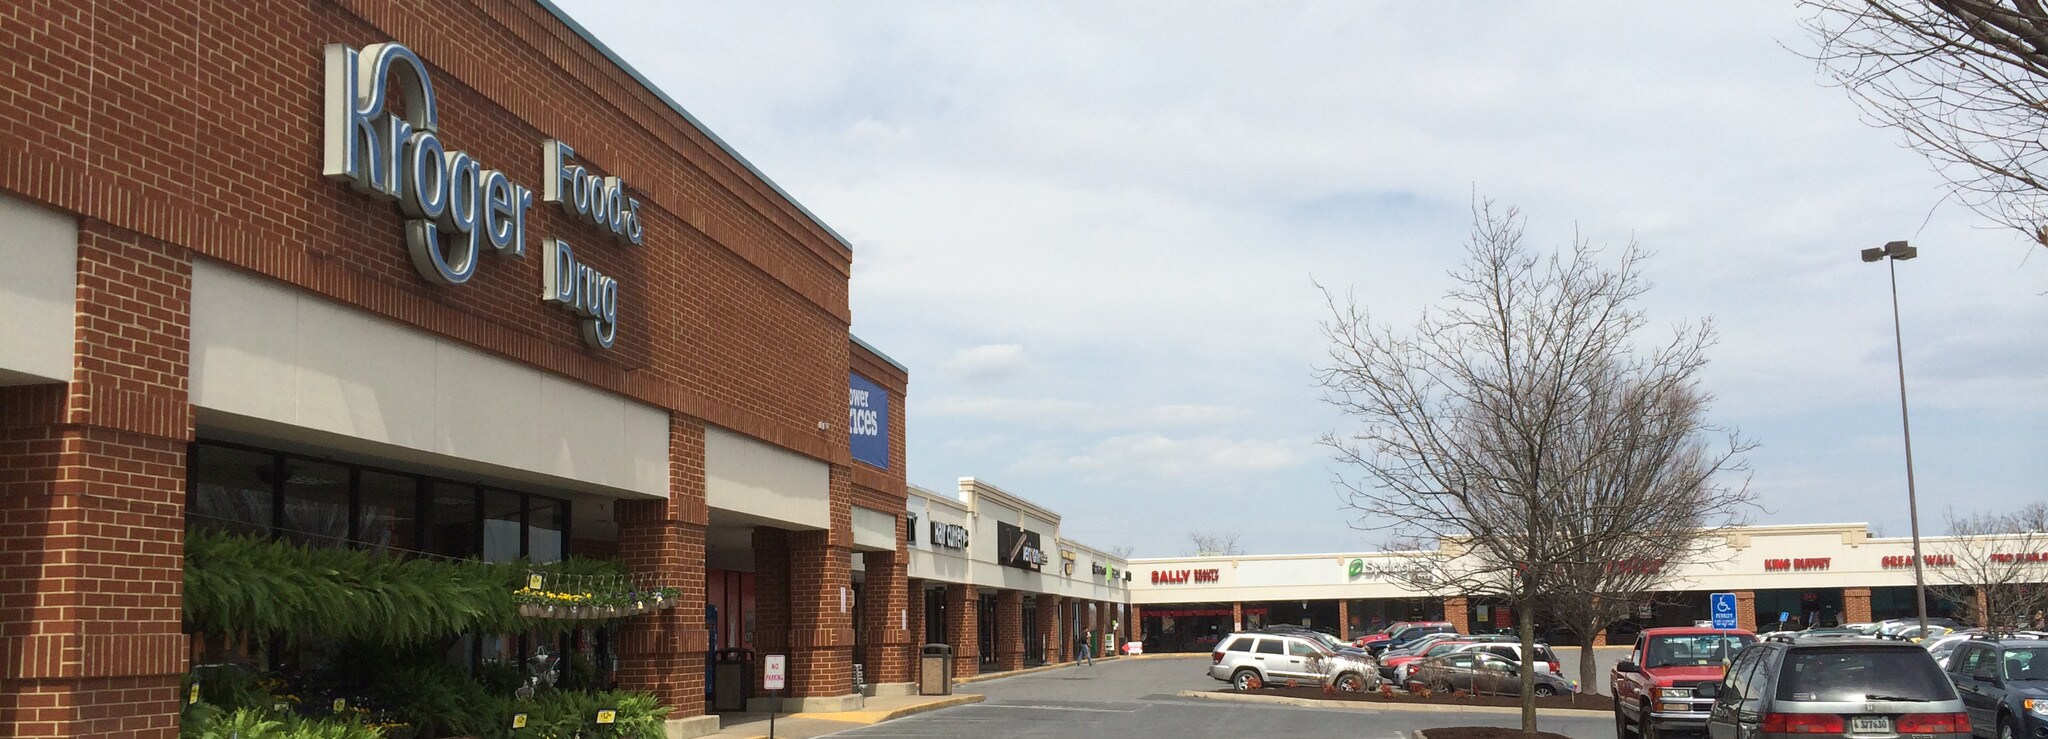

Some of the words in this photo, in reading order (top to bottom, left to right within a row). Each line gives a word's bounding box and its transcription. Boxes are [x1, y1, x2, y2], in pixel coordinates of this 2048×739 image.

[325, 42, 532, 284] Kroger
[544, 139, 623, 235] Food
[544, 237, 618, 349] Drug
[849, 388, 869, 407] ower
[1764, 559, 1791, 571] KING
[1793, 558, 1831, 571] BUFFET
[1882, 556, 1916, 568] GREA
[1924, 555, 1956, 566] WALL
[1151, 570, 1191, 584] SALLY
[765, 674, 784, 682] PARKING
